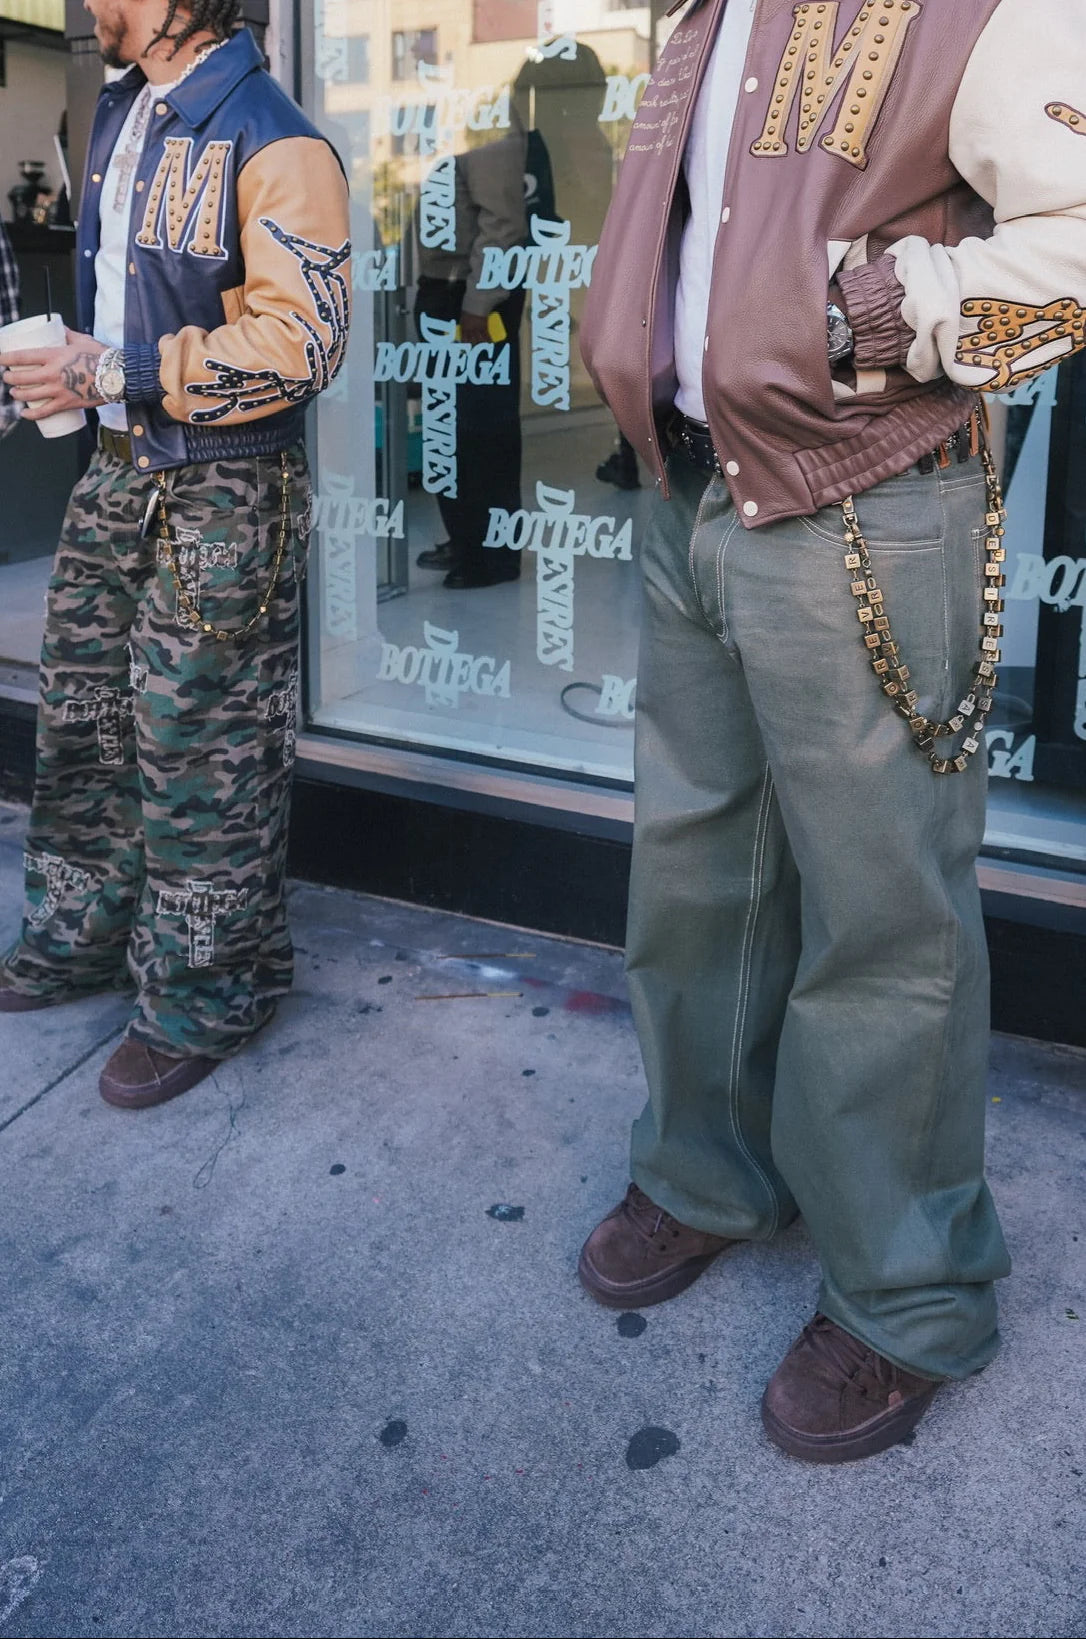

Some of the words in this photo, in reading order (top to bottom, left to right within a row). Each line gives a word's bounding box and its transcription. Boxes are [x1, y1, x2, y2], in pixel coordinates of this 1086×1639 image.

[373, 84, 511, 137] OTTEGA
[751, 0, 923, 171] M
[136, 138, 232, 260] M
[476, 245, 599, 290] BOTTE
[373, 342, 511, 386] BOTTEGA
[482, 507, 634, 561] BOTTEGA
[376, 642, 511, 698] BOTTEGA
